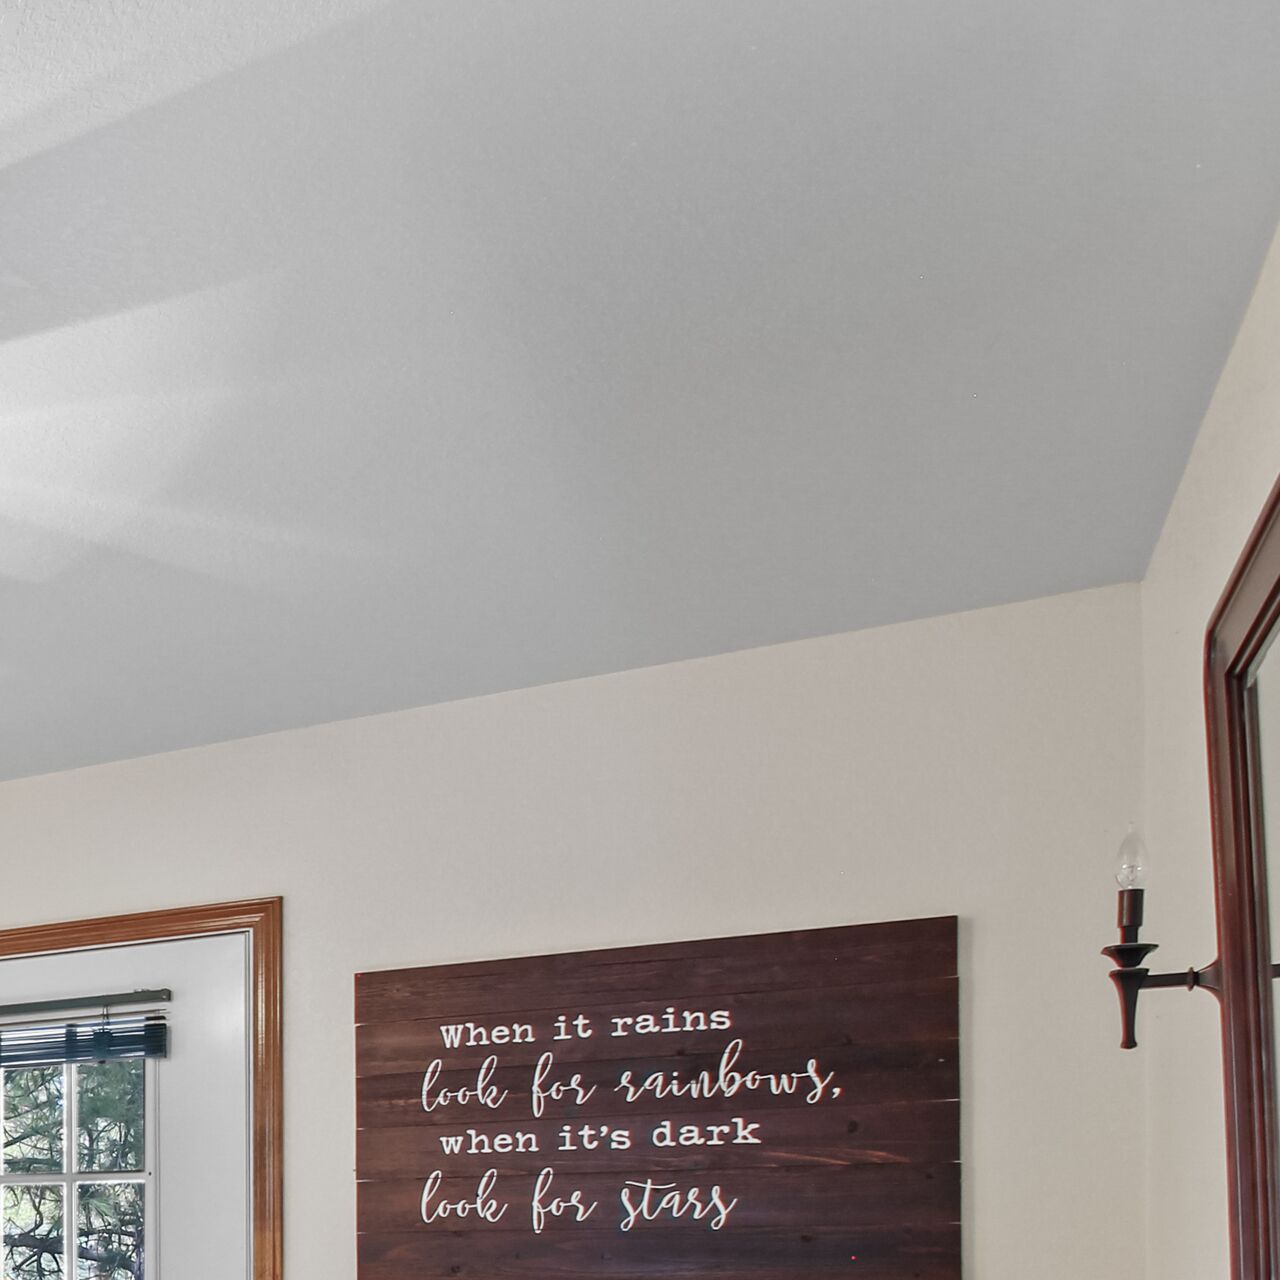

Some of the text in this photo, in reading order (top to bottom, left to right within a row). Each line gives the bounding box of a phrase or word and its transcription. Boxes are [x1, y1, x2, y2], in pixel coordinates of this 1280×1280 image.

[440, 1008, 731, 1048] When it rains
[421, 1039, 841, 1117] look for rainbows,
[440, 1118, 761, 1154] when it's dark
[421, 1168, 737, 1233] look for stars
